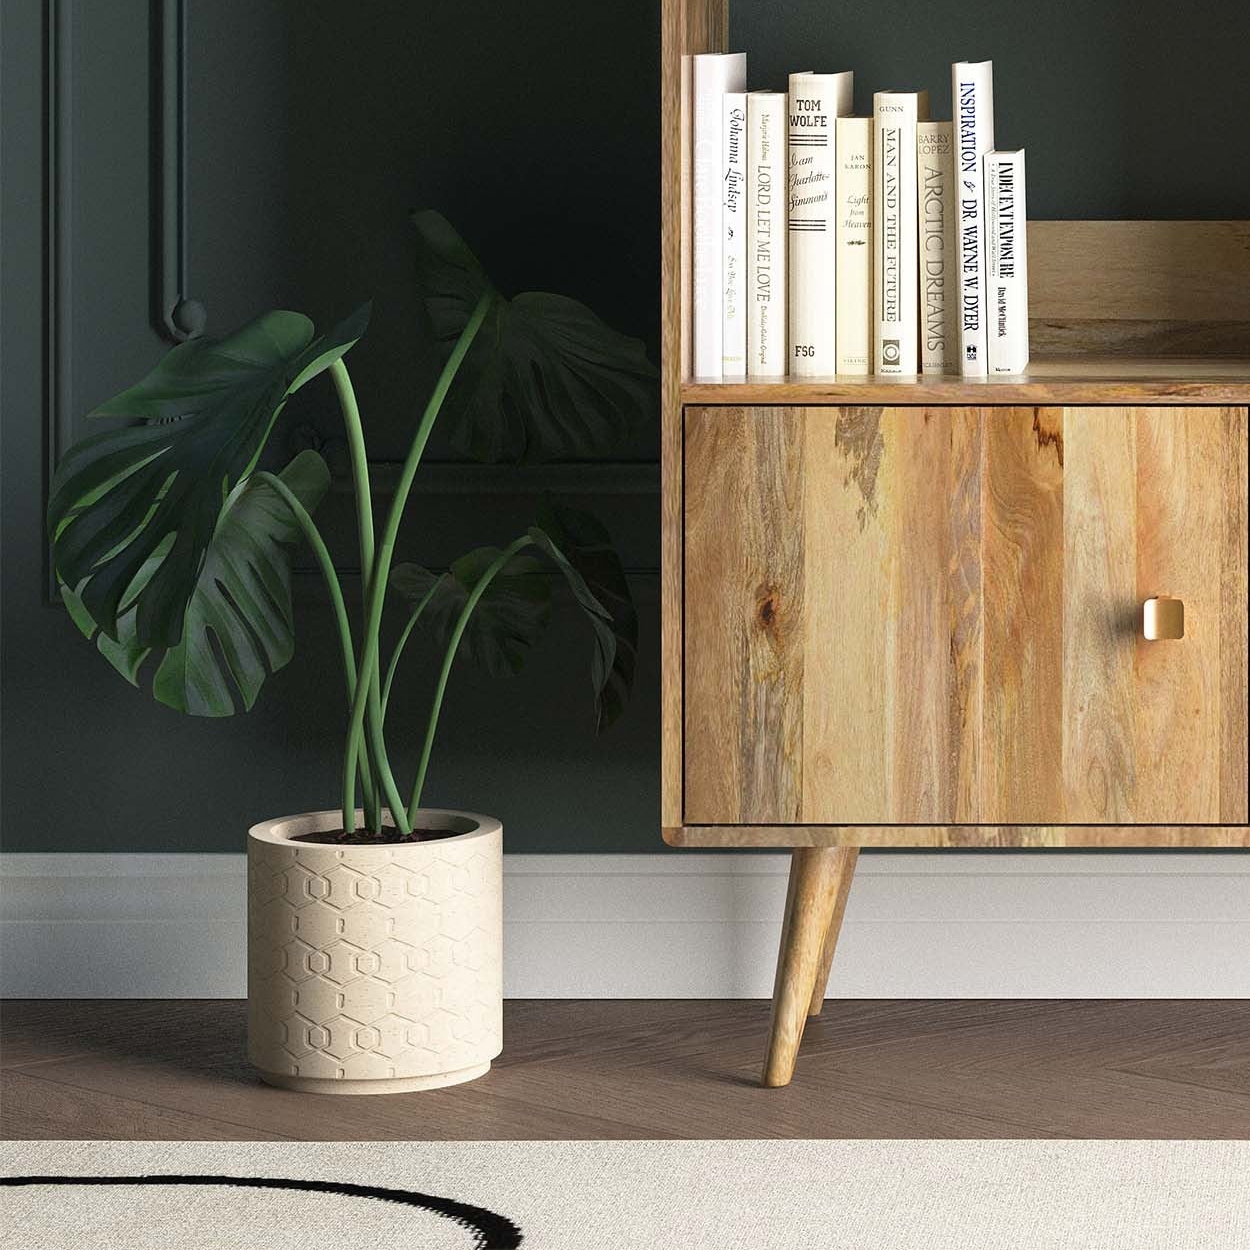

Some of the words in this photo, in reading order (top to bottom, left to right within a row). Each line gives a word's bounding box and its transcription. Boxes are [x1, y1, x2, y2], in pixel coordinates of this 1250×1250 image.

[789, 115, 828, 127] WOLFE
[796, 99, 821, 112] TOM
[728, 108, 745, 164] Johanna
[919, 134, 950, 144] BARRY
[960, 82, 978, 172] INSPIRATION
[798, 156, 815, 165] am
[886, 128, 897, 167] MAN
[919, 145, 950, 155] LOPEZ
[724, 168, 744, 213] Lindsey
[756, 165, 771, 207] LORD,
[846, 194, 869, 207] Light
[886, 172, 897, 209] AND
[998, 162, 1014, 219] INDECENT
[756, 210, 771, 238] LET
[843, 220, 872, 229] Heaven
[924, 166, 944, 251] ARCTIC
[962, 199, 977, 222] DR.
[886, 214, 897, 250] THE
[962, 226, 978, 273] WAYNE
[999, 221, 1014, 279] EXPOSURE
[756, 240, 771, 262] ME
[756, 266, 771, 302] LOVE
[886, 256, 897, 322] FUTURE
[963, 276, 978, 291] W.
[997, 287, 1007, 304] David
[926, 260, 945, 351] DREAMS
[963, 294, 979, 331] DYER
[795, 345, 815, 357] FSG
